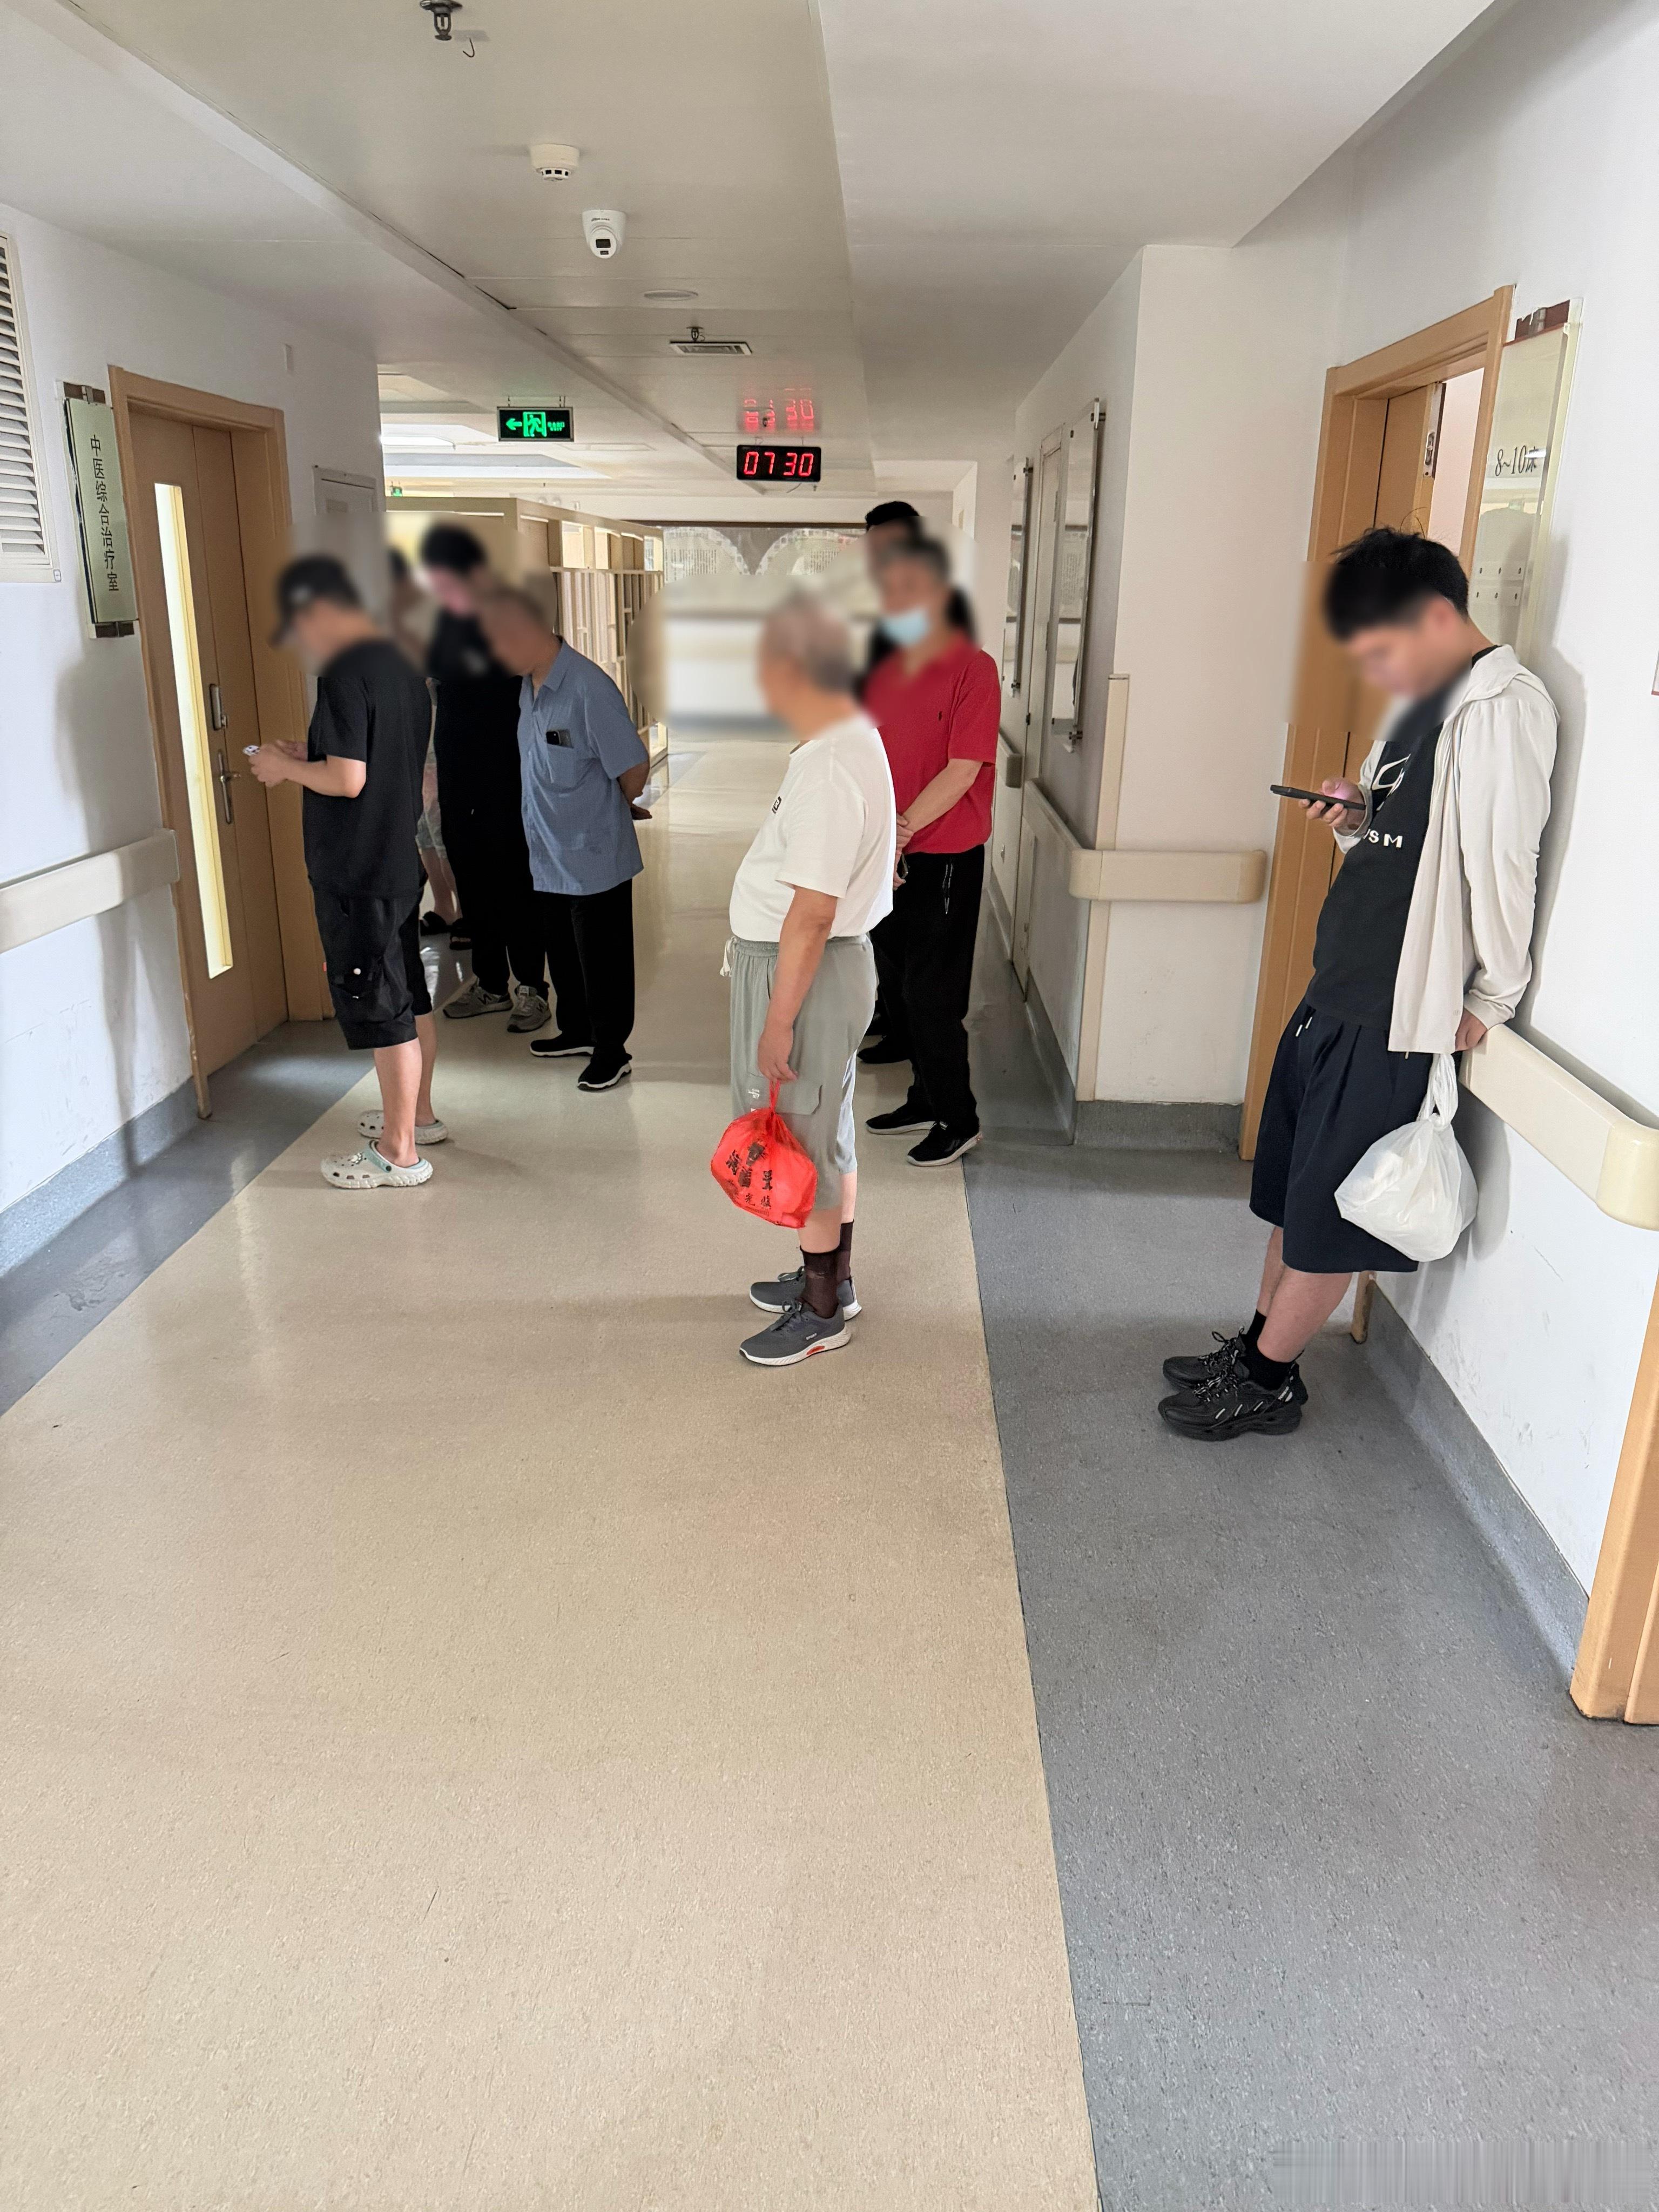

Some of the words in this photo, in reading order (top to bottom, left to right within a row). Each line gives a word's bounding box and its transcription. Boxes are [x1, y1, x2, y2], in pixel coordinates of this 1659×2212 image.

[90, 434, 119, 591] 中医综合治疗室
